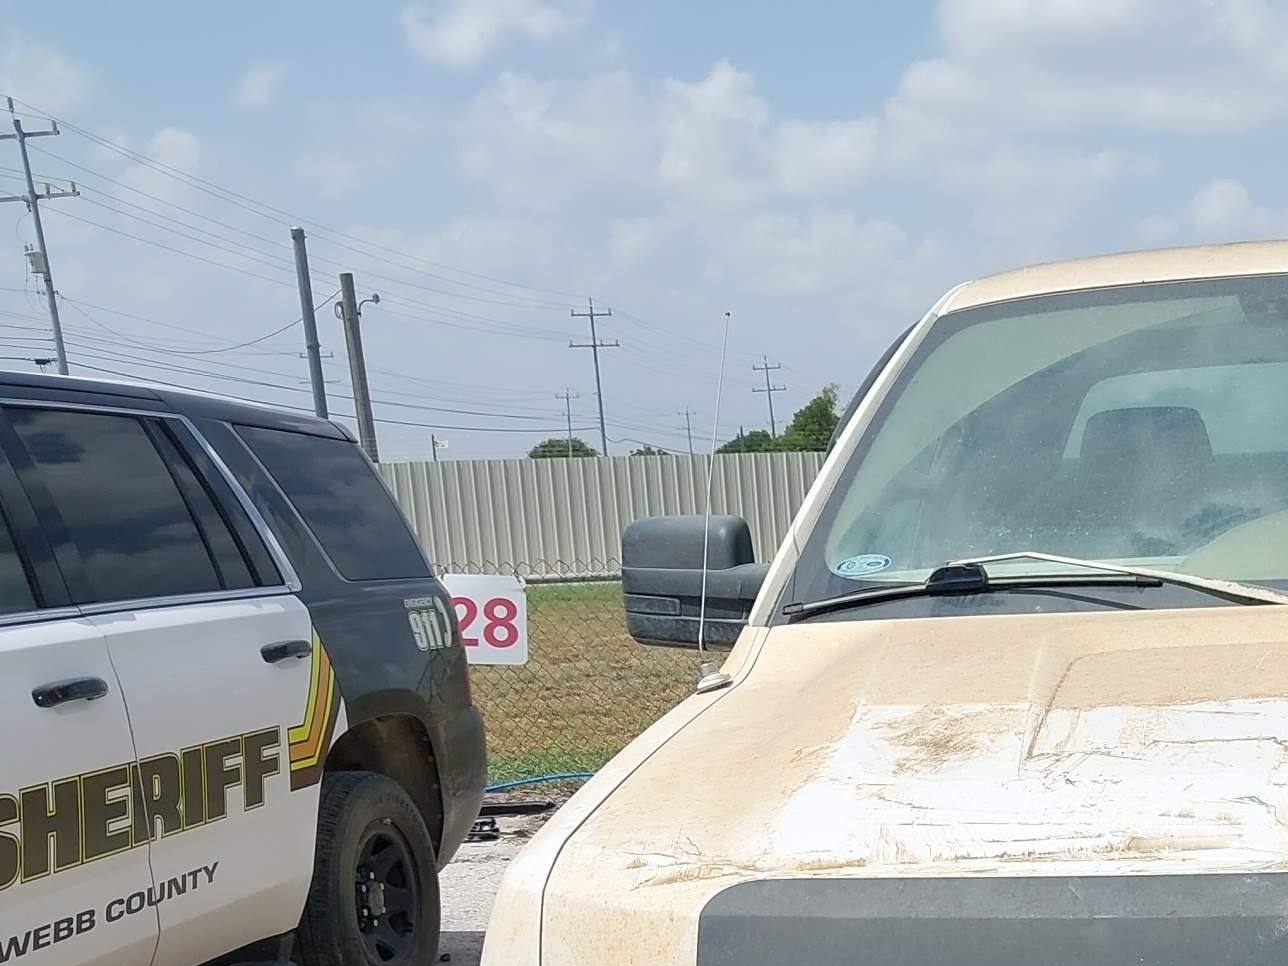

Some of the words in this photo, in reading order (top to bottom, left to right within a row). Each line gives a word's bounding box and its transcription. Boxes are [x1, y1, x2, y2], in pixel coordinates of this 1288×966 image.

[408, 610, 444, 652] 911
[452, 597, 519, 648] 28
[105, 861, 219, 922] COUNTY
